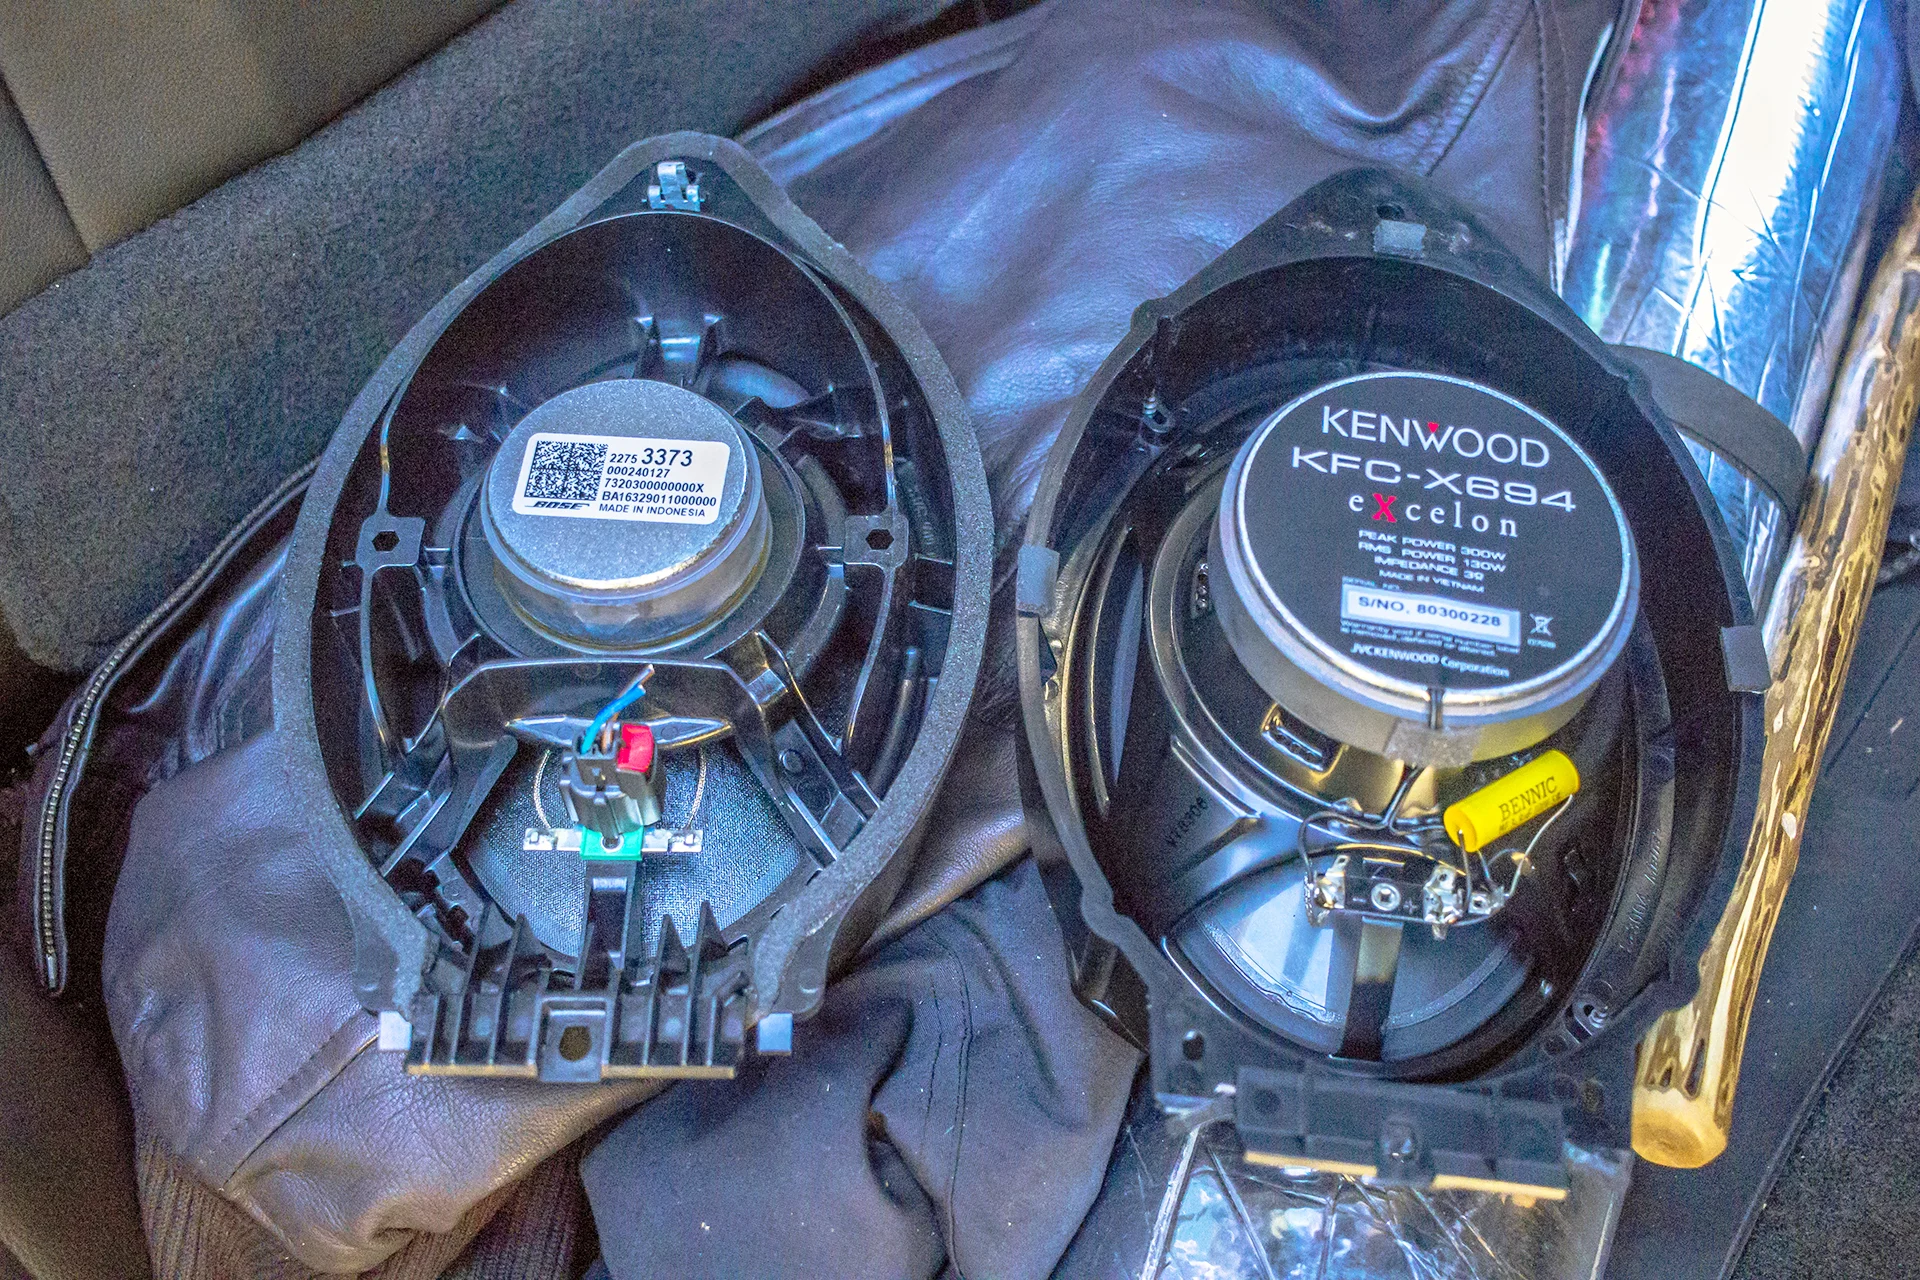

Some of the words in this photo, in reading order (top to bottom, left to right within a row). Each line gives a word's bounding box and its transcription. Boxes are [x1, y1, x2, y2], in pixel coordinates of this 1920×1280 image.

[1322, 406, 1549, 467] KENWOOD
[609, 453, 638, 465] 2275
[641, 447, 693, 467] 3373
[606, 465, 670, 479] 000240127
[1292, 447, 1576, 512] KFC-X694
[604, 477, 705, 493] 7320300000000X
[525, 500, 590, 511] BOSE
[599, 503, 629, 514] MADE
[632, 505, 644, 514] IN
[647, 505, 705, 517] INDONESIA
[602, 490, 717, 507] BA16329011000000
[1358, 529, 1398, 544] PEAK
[1401, 536, 1457, 553] POWER
[1460, 546, 1507, 561] 300W
[1358, 541, 1392, 555] RMS
[1401, 548, 1456, 564] POWER
[1463, 558, 1507, 573] 130W
[1374, 555, 1459, 577] IMPEDANCE
[1378, 569, 1414, 582] MADE
[1416, 574, 1430, 583] IN
[1432, 576, 1485, 593] VIETNAM
[1358, 596, 1410, 614] S/NO.
[1417, 604, 1501, 626] 80300228
[1440, 655, 1510, 679] Corporation
[1499, 776, 1558, 822] BENNIC
